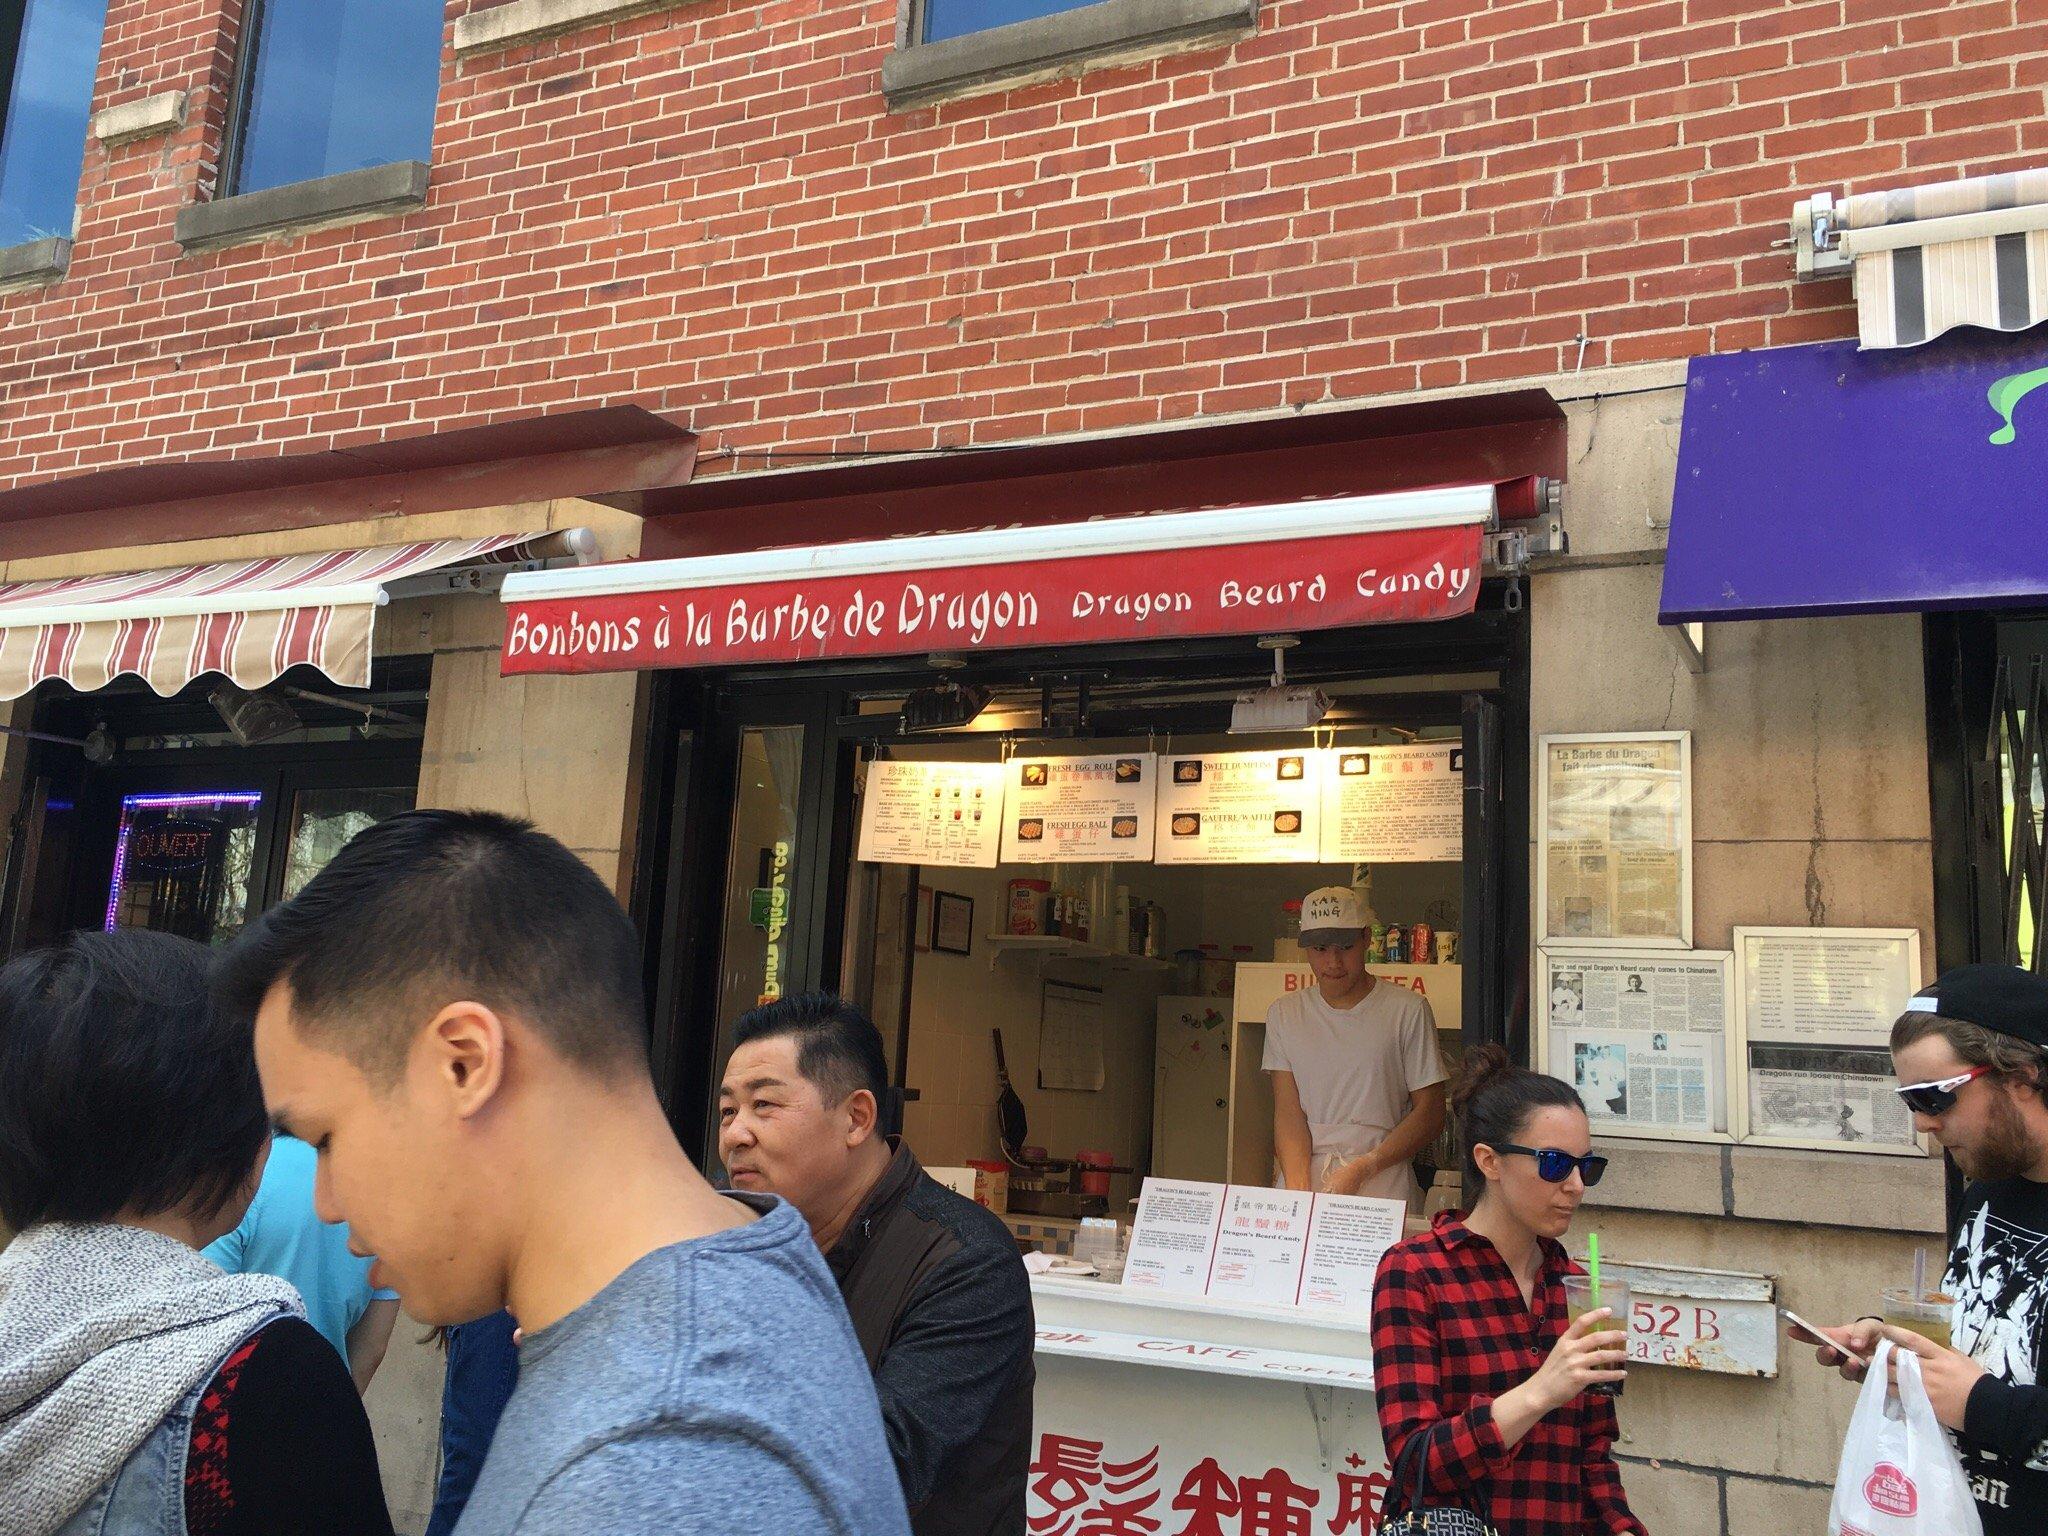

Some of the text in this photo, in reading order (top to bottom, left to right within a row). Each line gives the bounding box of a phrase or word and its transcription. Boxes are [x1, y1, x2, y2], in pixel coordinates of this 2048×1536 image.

[1072, 561, 1471, 622] Dragon Beard Candy
[508, 581, 1038, 657] Bonbons à la Barbe de Dragon
[1572, 749, 1602, 760] Barbe
[1605, 748, 1619, 759] du
[1048, 762, 1115, 773] FRESH EGG ROLL
[1046, 821, 1072, 830] FRESH
[1072, 821, 1088, 829] EGG
[137, 833, 212, 857] OUVERT
[1311, 906, 1341, 919] MING
[1593, 964, 1619, 972] Dragon's
[1639, 966, 1656, 974] candy
[1760, 1069, 1792, 1078] Dragons
[1810, 1071, 1831, 1079] loose
[1841, 1073, 1884, 1082] Chinatown
[1222, 1229, 1301, 1242] Dragon's Beard Candy
[1633, 1302, 1720, 1341] 52 B
[1137, 1340, 1258, 1361] CAFE
[1262, 1362, 1374, 1380] COFFE
